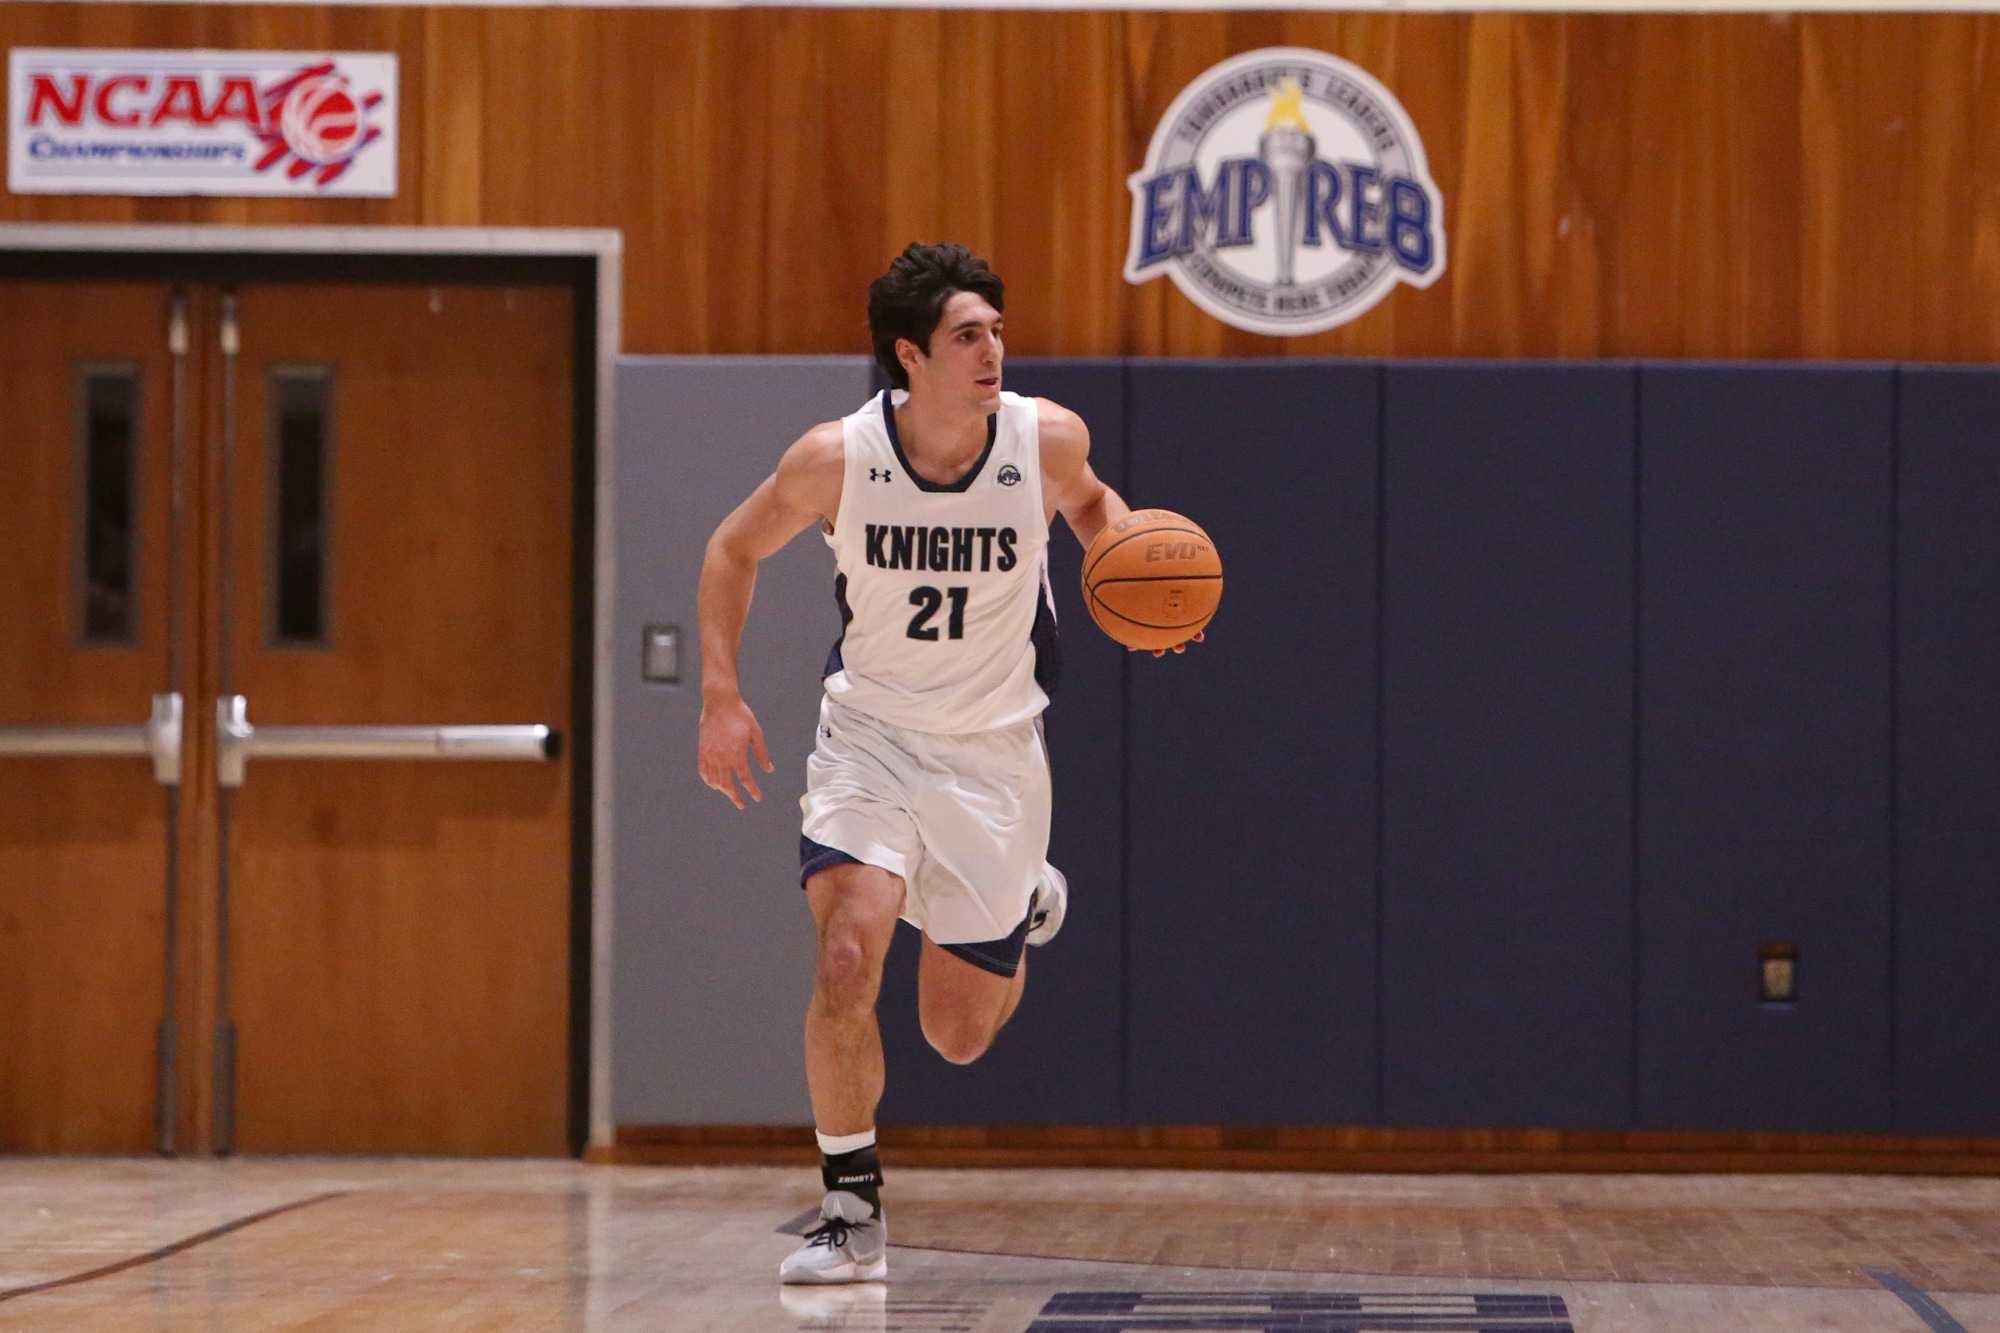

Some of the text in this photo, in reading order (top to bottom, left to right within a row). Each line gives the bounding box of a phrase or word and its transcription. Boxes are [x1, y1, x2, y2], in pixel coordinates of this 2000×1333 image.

[29, 77, 262, 126] NCAA
[865, 524, 1018, 572] KNIGHTS
[1145, 542, 1198, 562] EVO
[906, 586, 969, 641] 21
